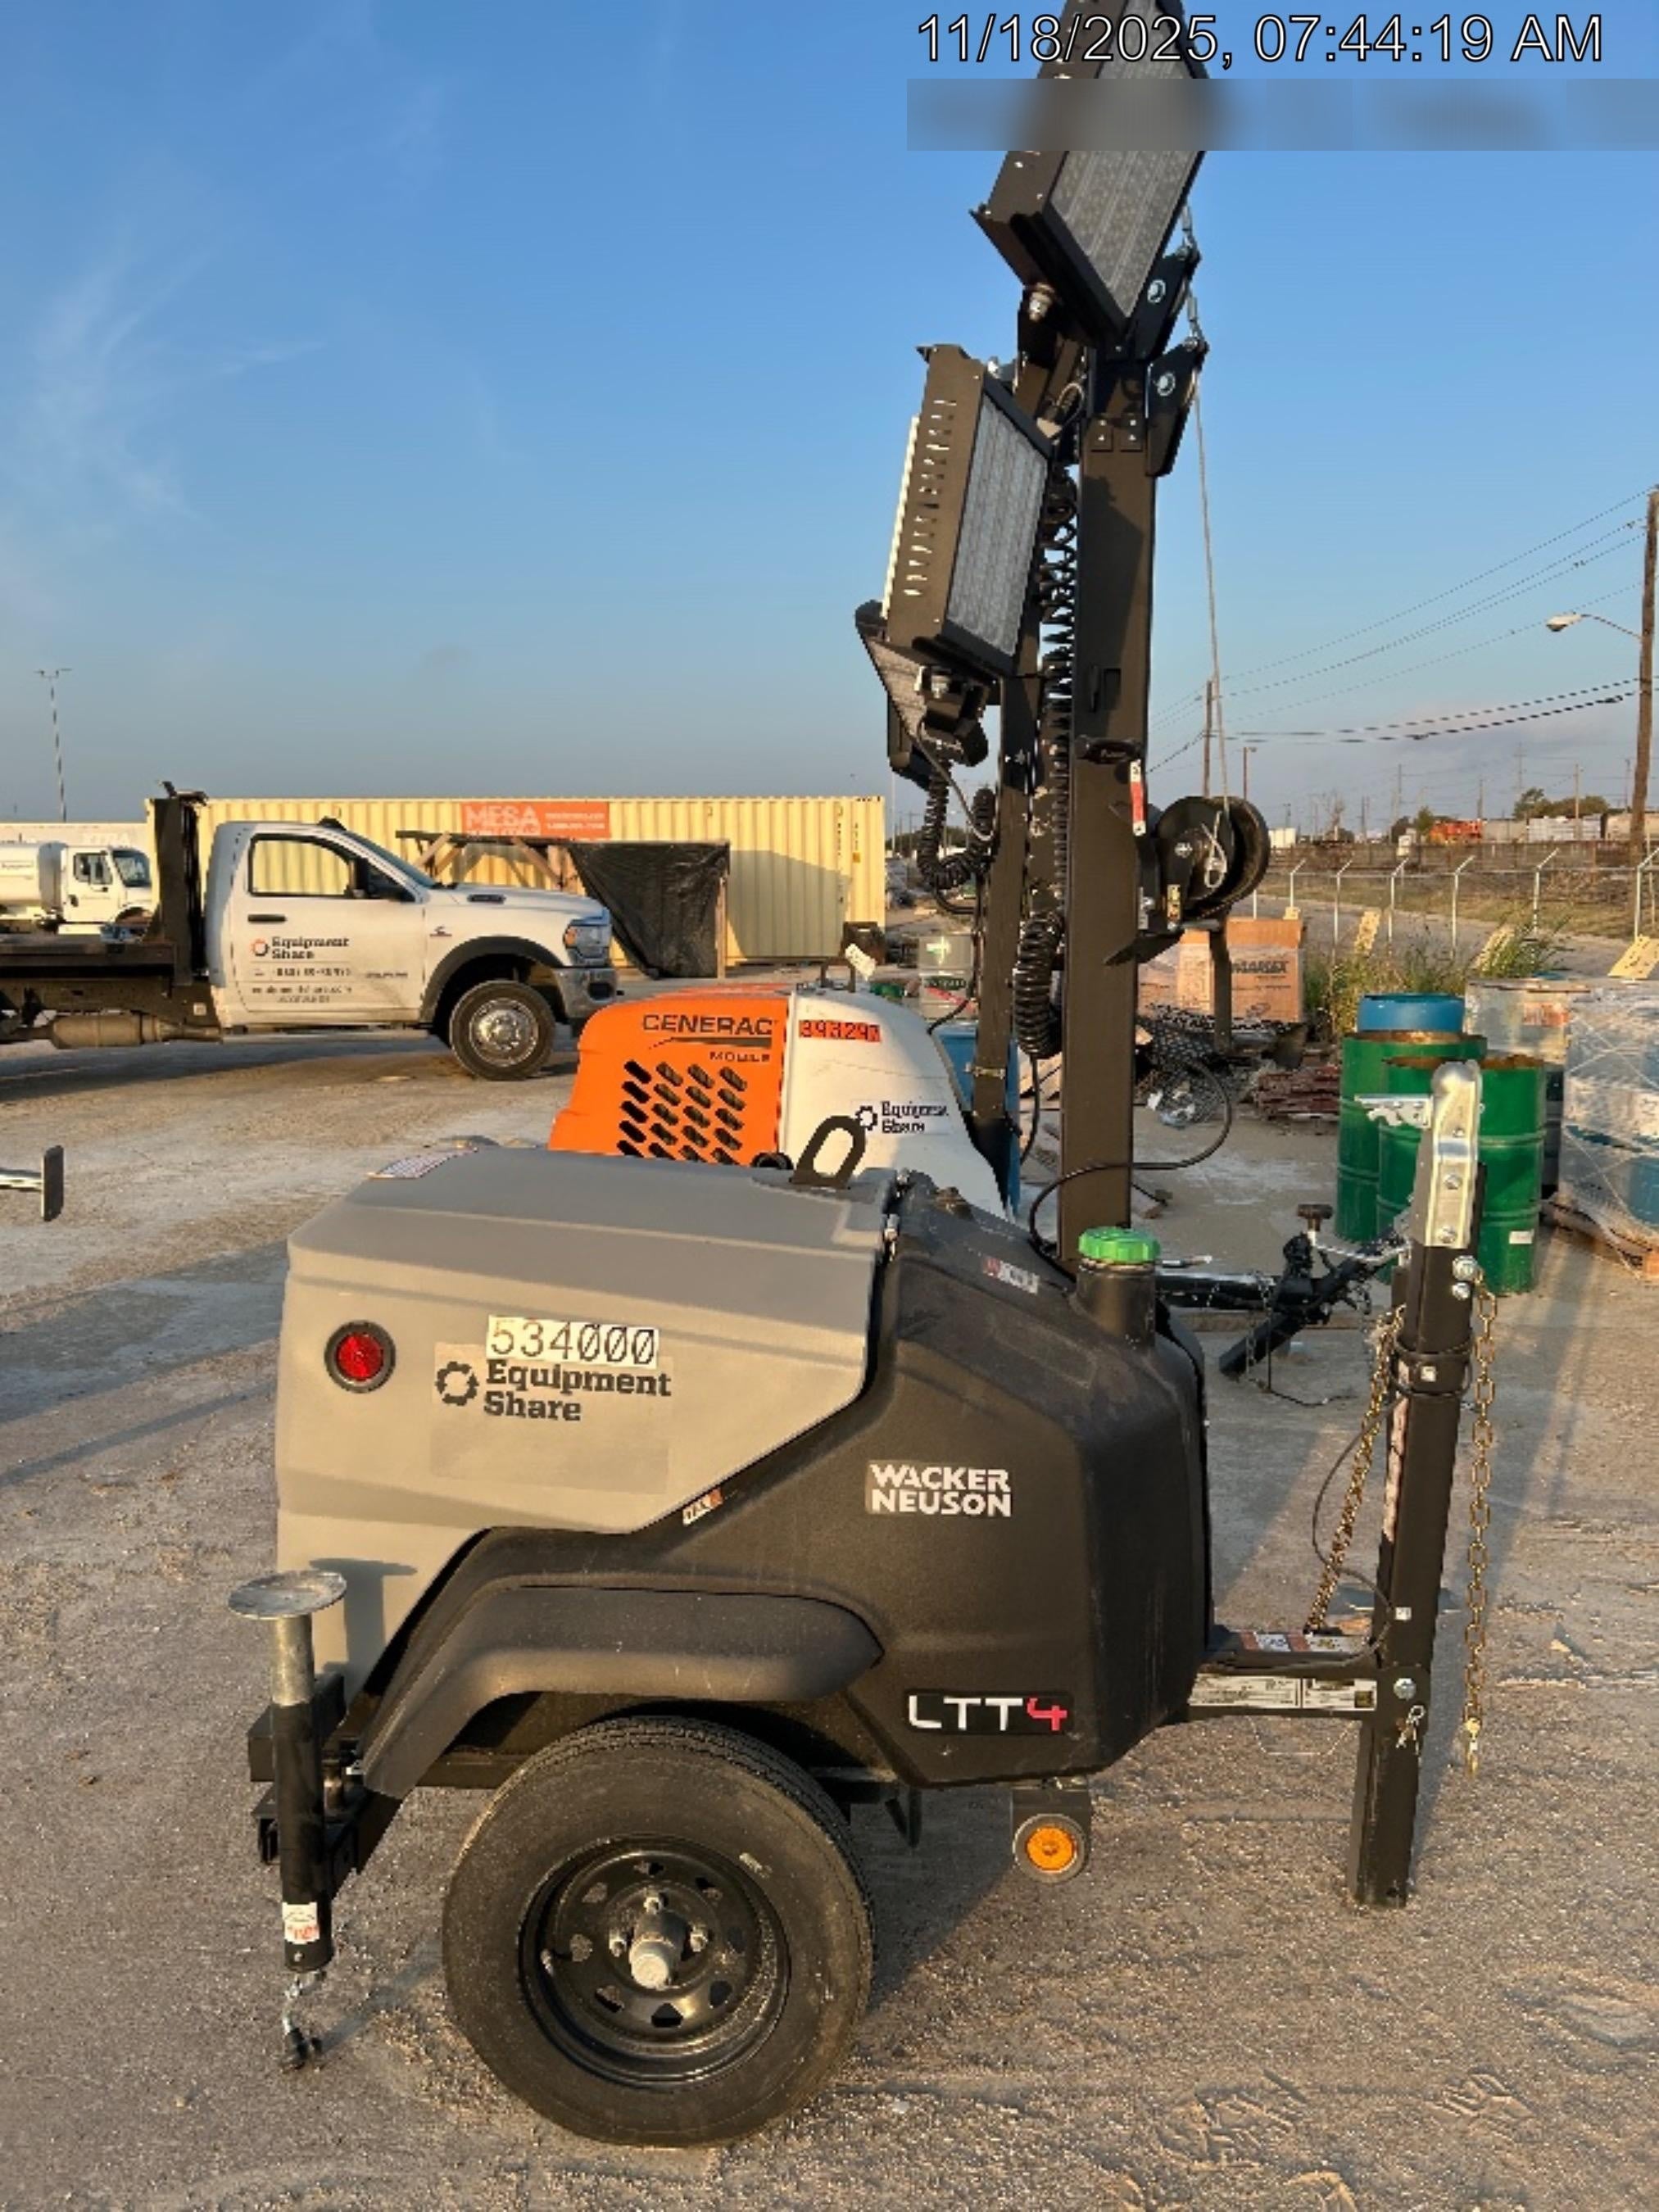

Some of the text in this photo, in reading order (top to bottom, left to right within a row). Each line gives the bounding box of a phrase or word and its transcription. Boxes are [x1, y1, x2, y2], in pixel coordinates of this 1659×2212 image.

[465, 805, 540, 830] MESA
[642, 1014, 773, 1036] GENERAC
[490, 1318, 655, 1366] 534000
[486, 1358, 672, 1396] Equipment
[483, 1390, 582, 1421] Share
[869, 1463, 1012, 1493] WACKER
[870, 1489, 1012, 1517] NEUSON
[908, 1695, 1068, 1731] LTT4
